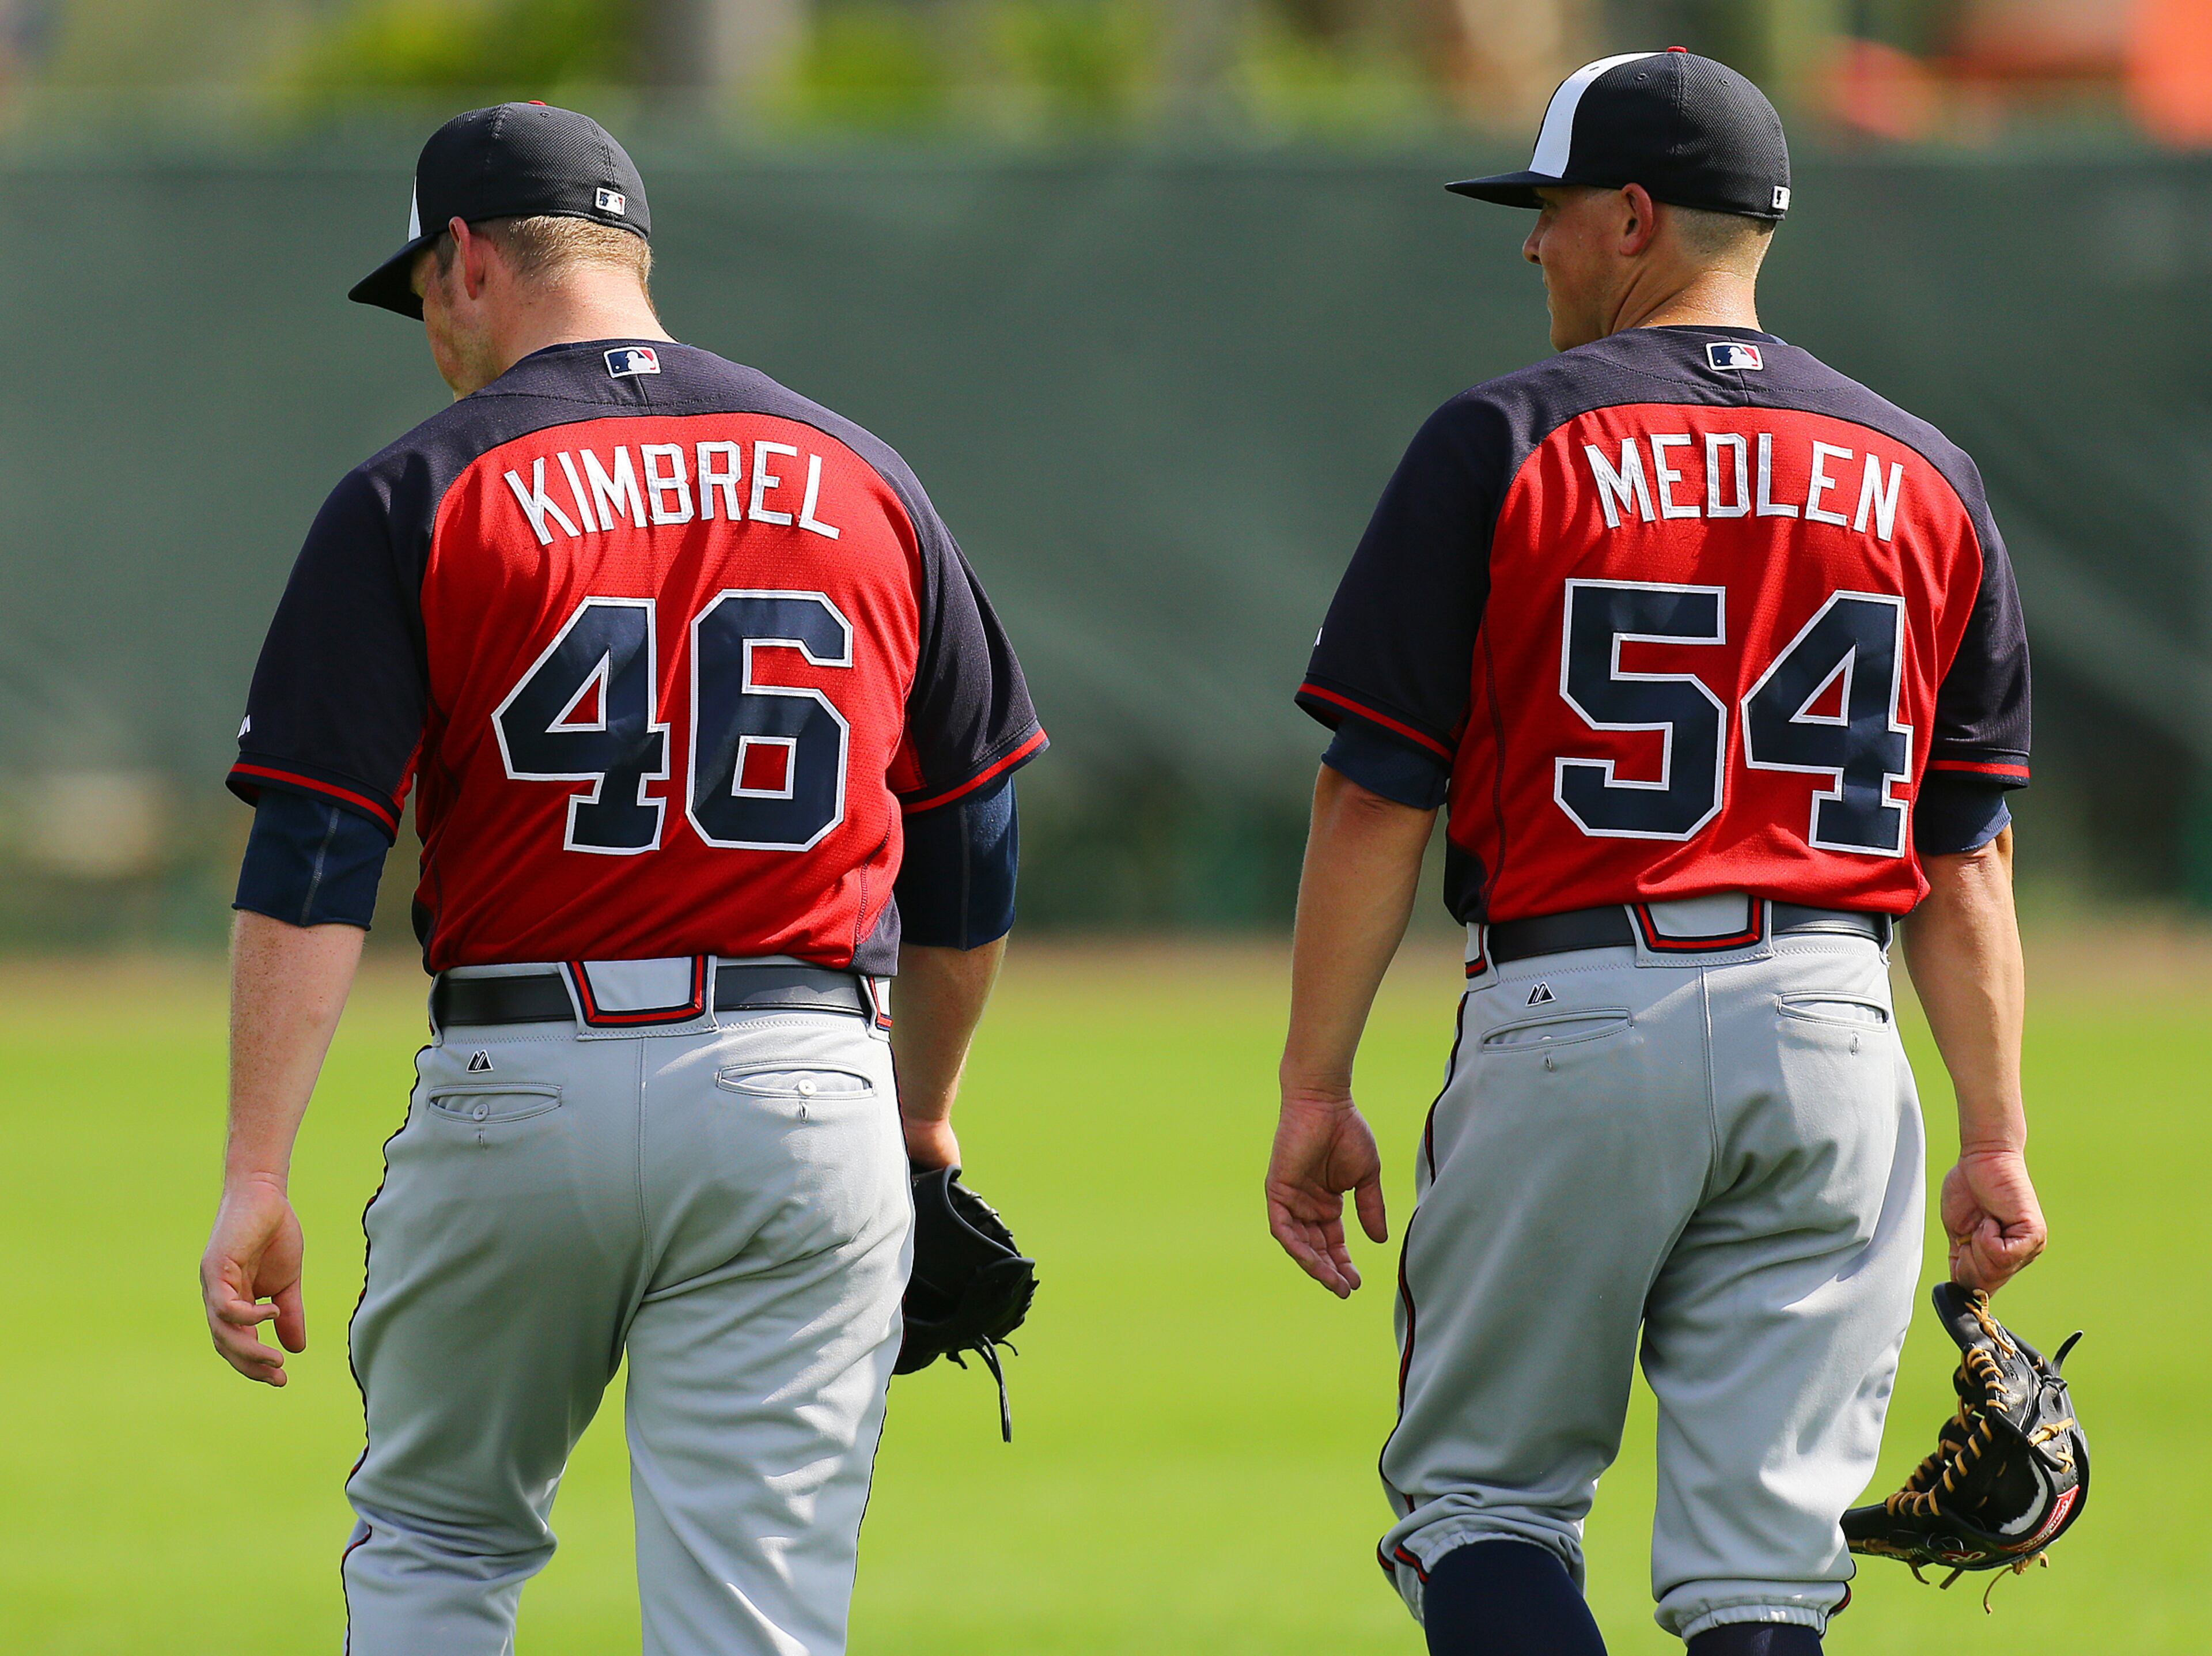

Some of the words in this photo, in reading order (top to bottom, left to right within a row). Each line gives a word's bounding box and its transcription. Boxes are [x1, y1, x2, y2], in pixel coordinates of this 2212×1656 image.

[503, 440, 840, 546] KIMBREL
[1584, 433, 1904, 542] MEDLEN
[491, 589, 853, 855] 46
[1554, 578, 1914, 858] 54
